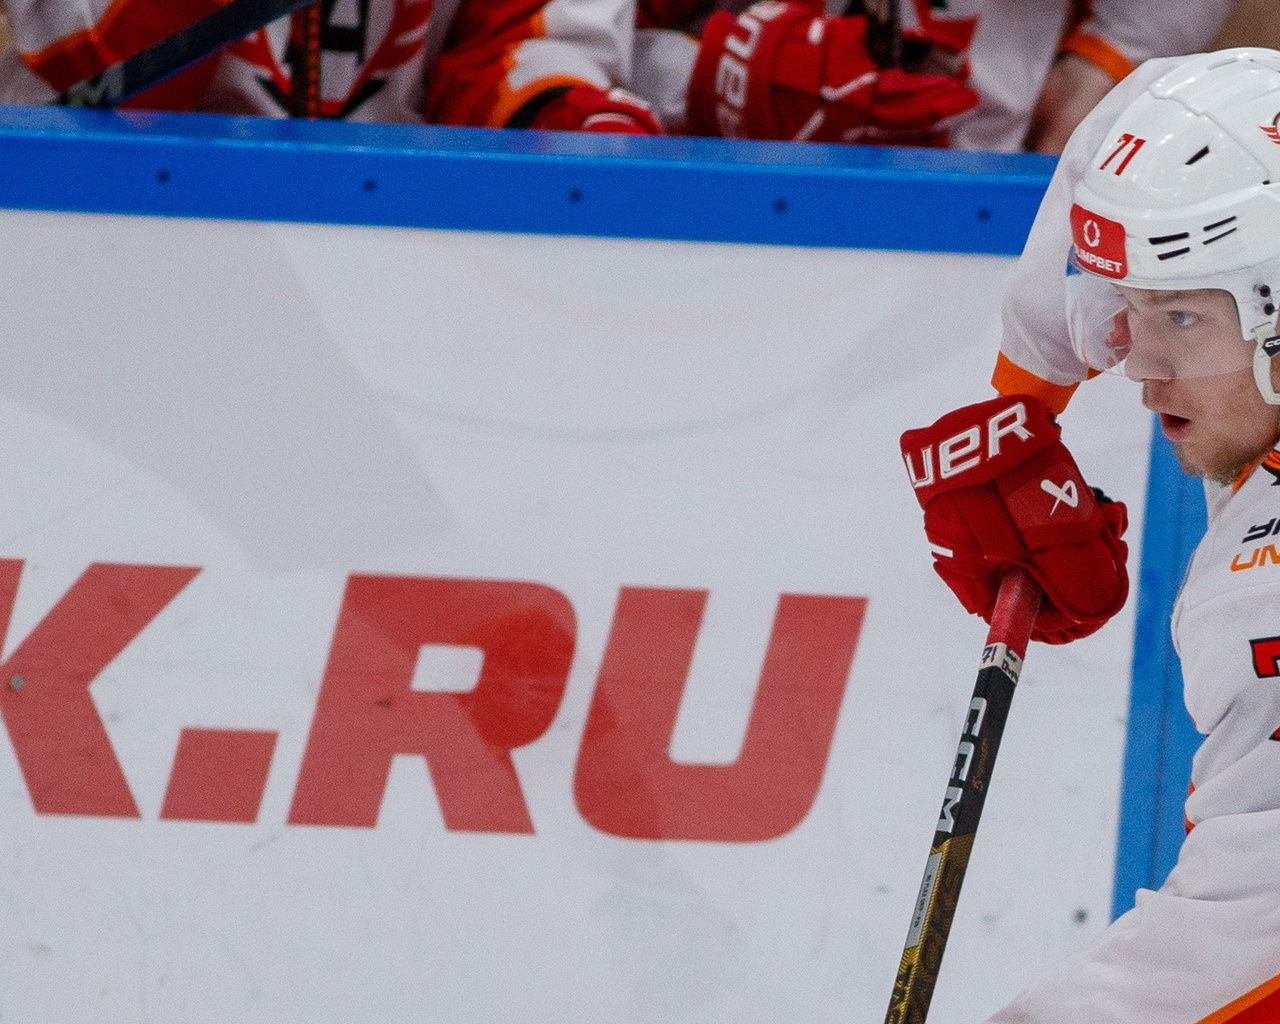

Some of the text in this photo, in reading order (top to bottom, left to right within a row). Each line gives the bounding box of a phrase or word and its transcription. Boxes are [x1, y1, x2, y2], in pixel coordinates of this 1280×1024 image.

[1099, 133, 1146, 176] 71
[0, 558, 870, 845] K.RU
[937, 697, 987, 833] CCM
